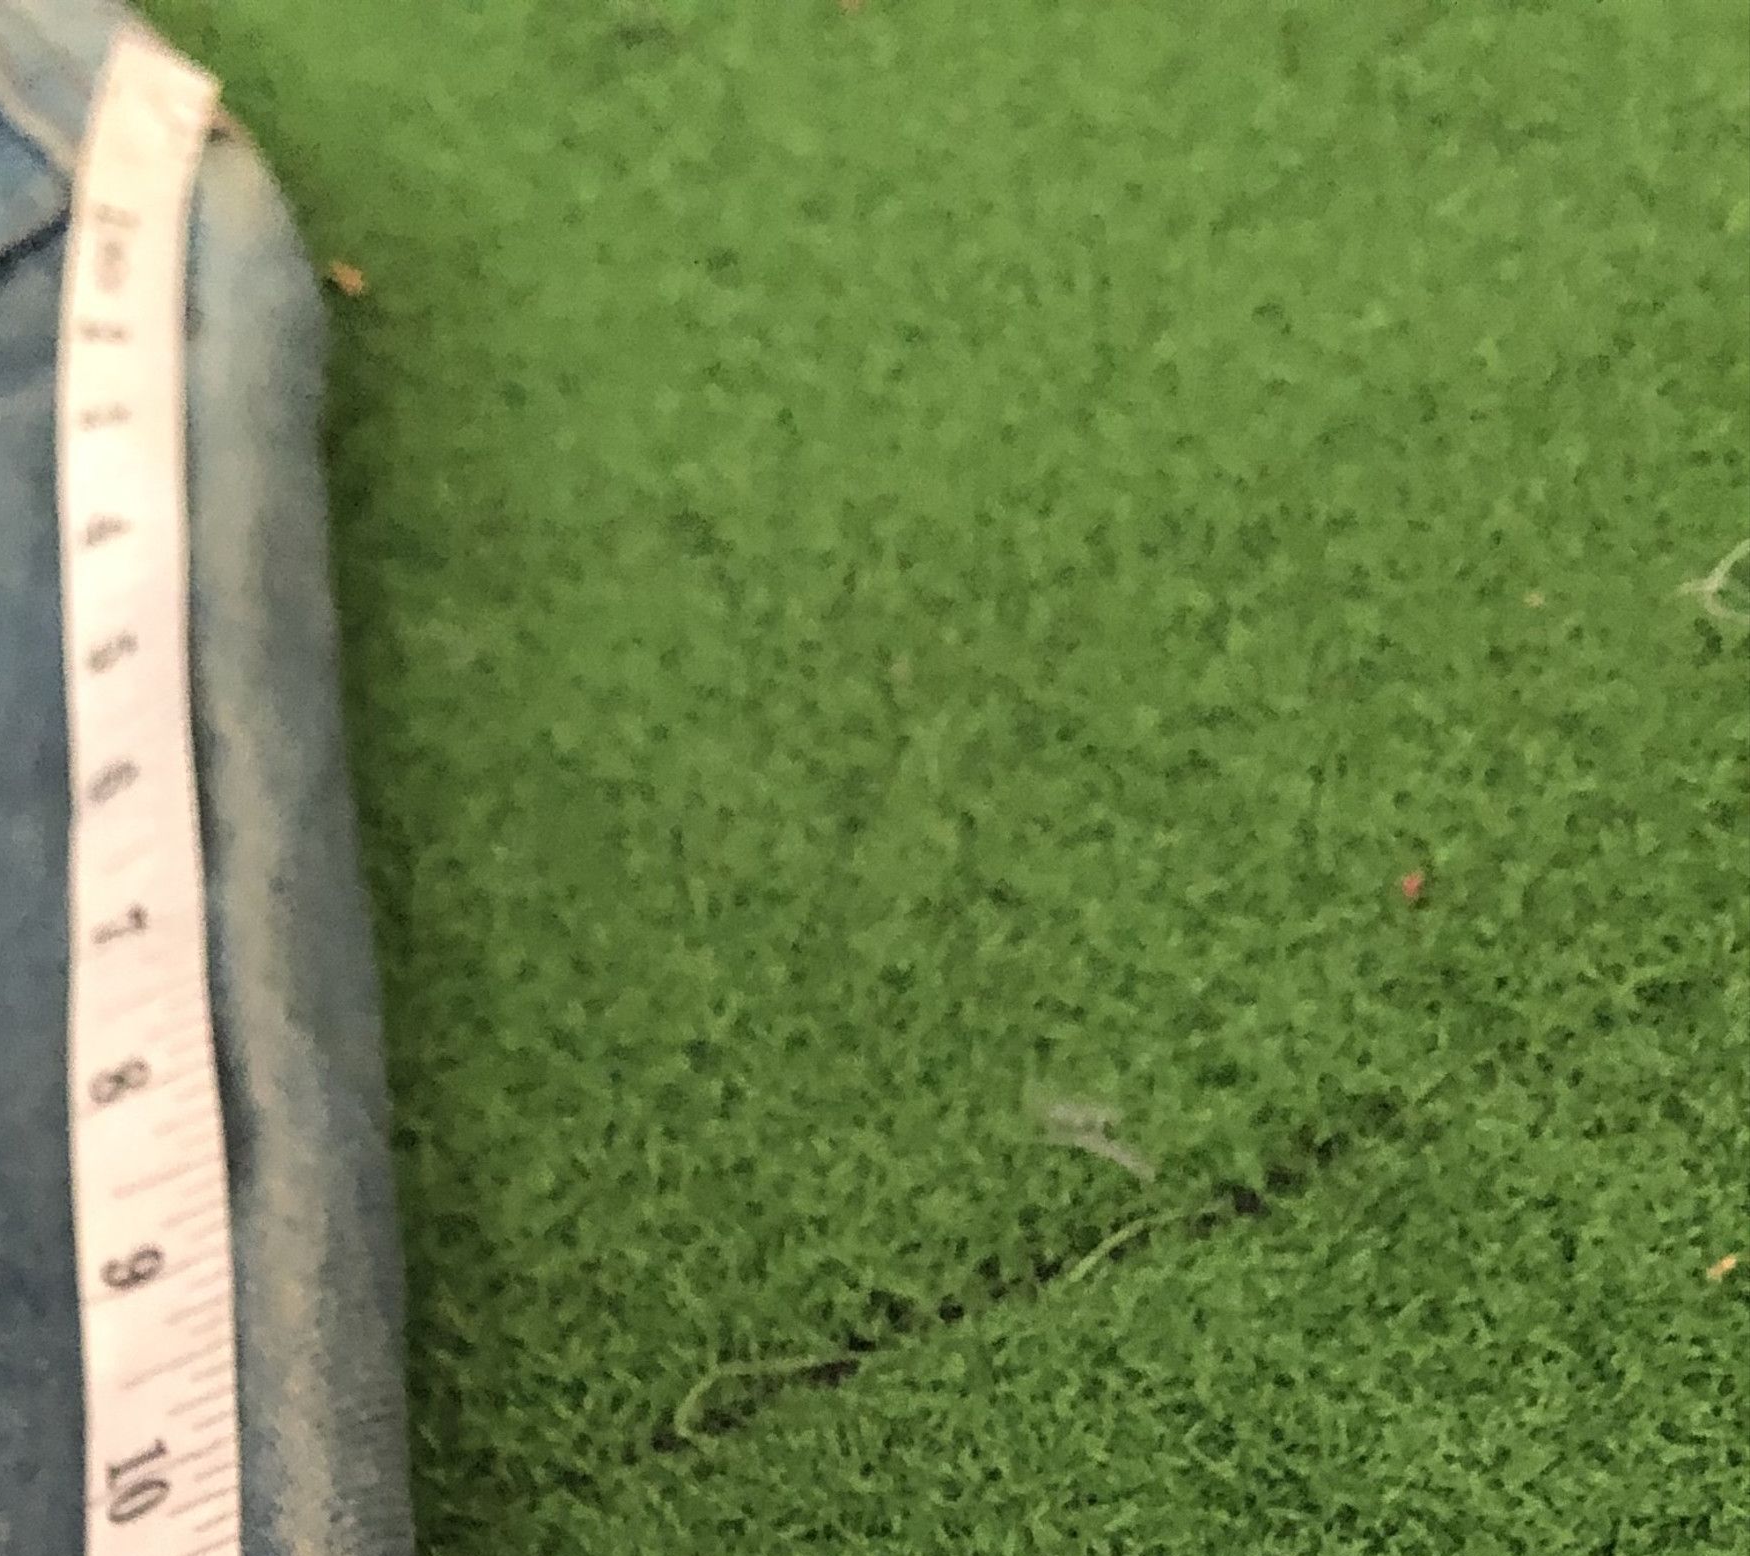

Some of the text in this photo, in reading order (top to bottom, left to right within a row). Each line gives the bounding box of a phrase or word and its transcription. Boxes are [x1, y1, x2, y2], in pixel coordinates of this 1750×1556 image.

[89, 1056, 151, 1105] 8
[99, 1243, 164, 1292] 9
[105, 1437, 171, 1526] 10
